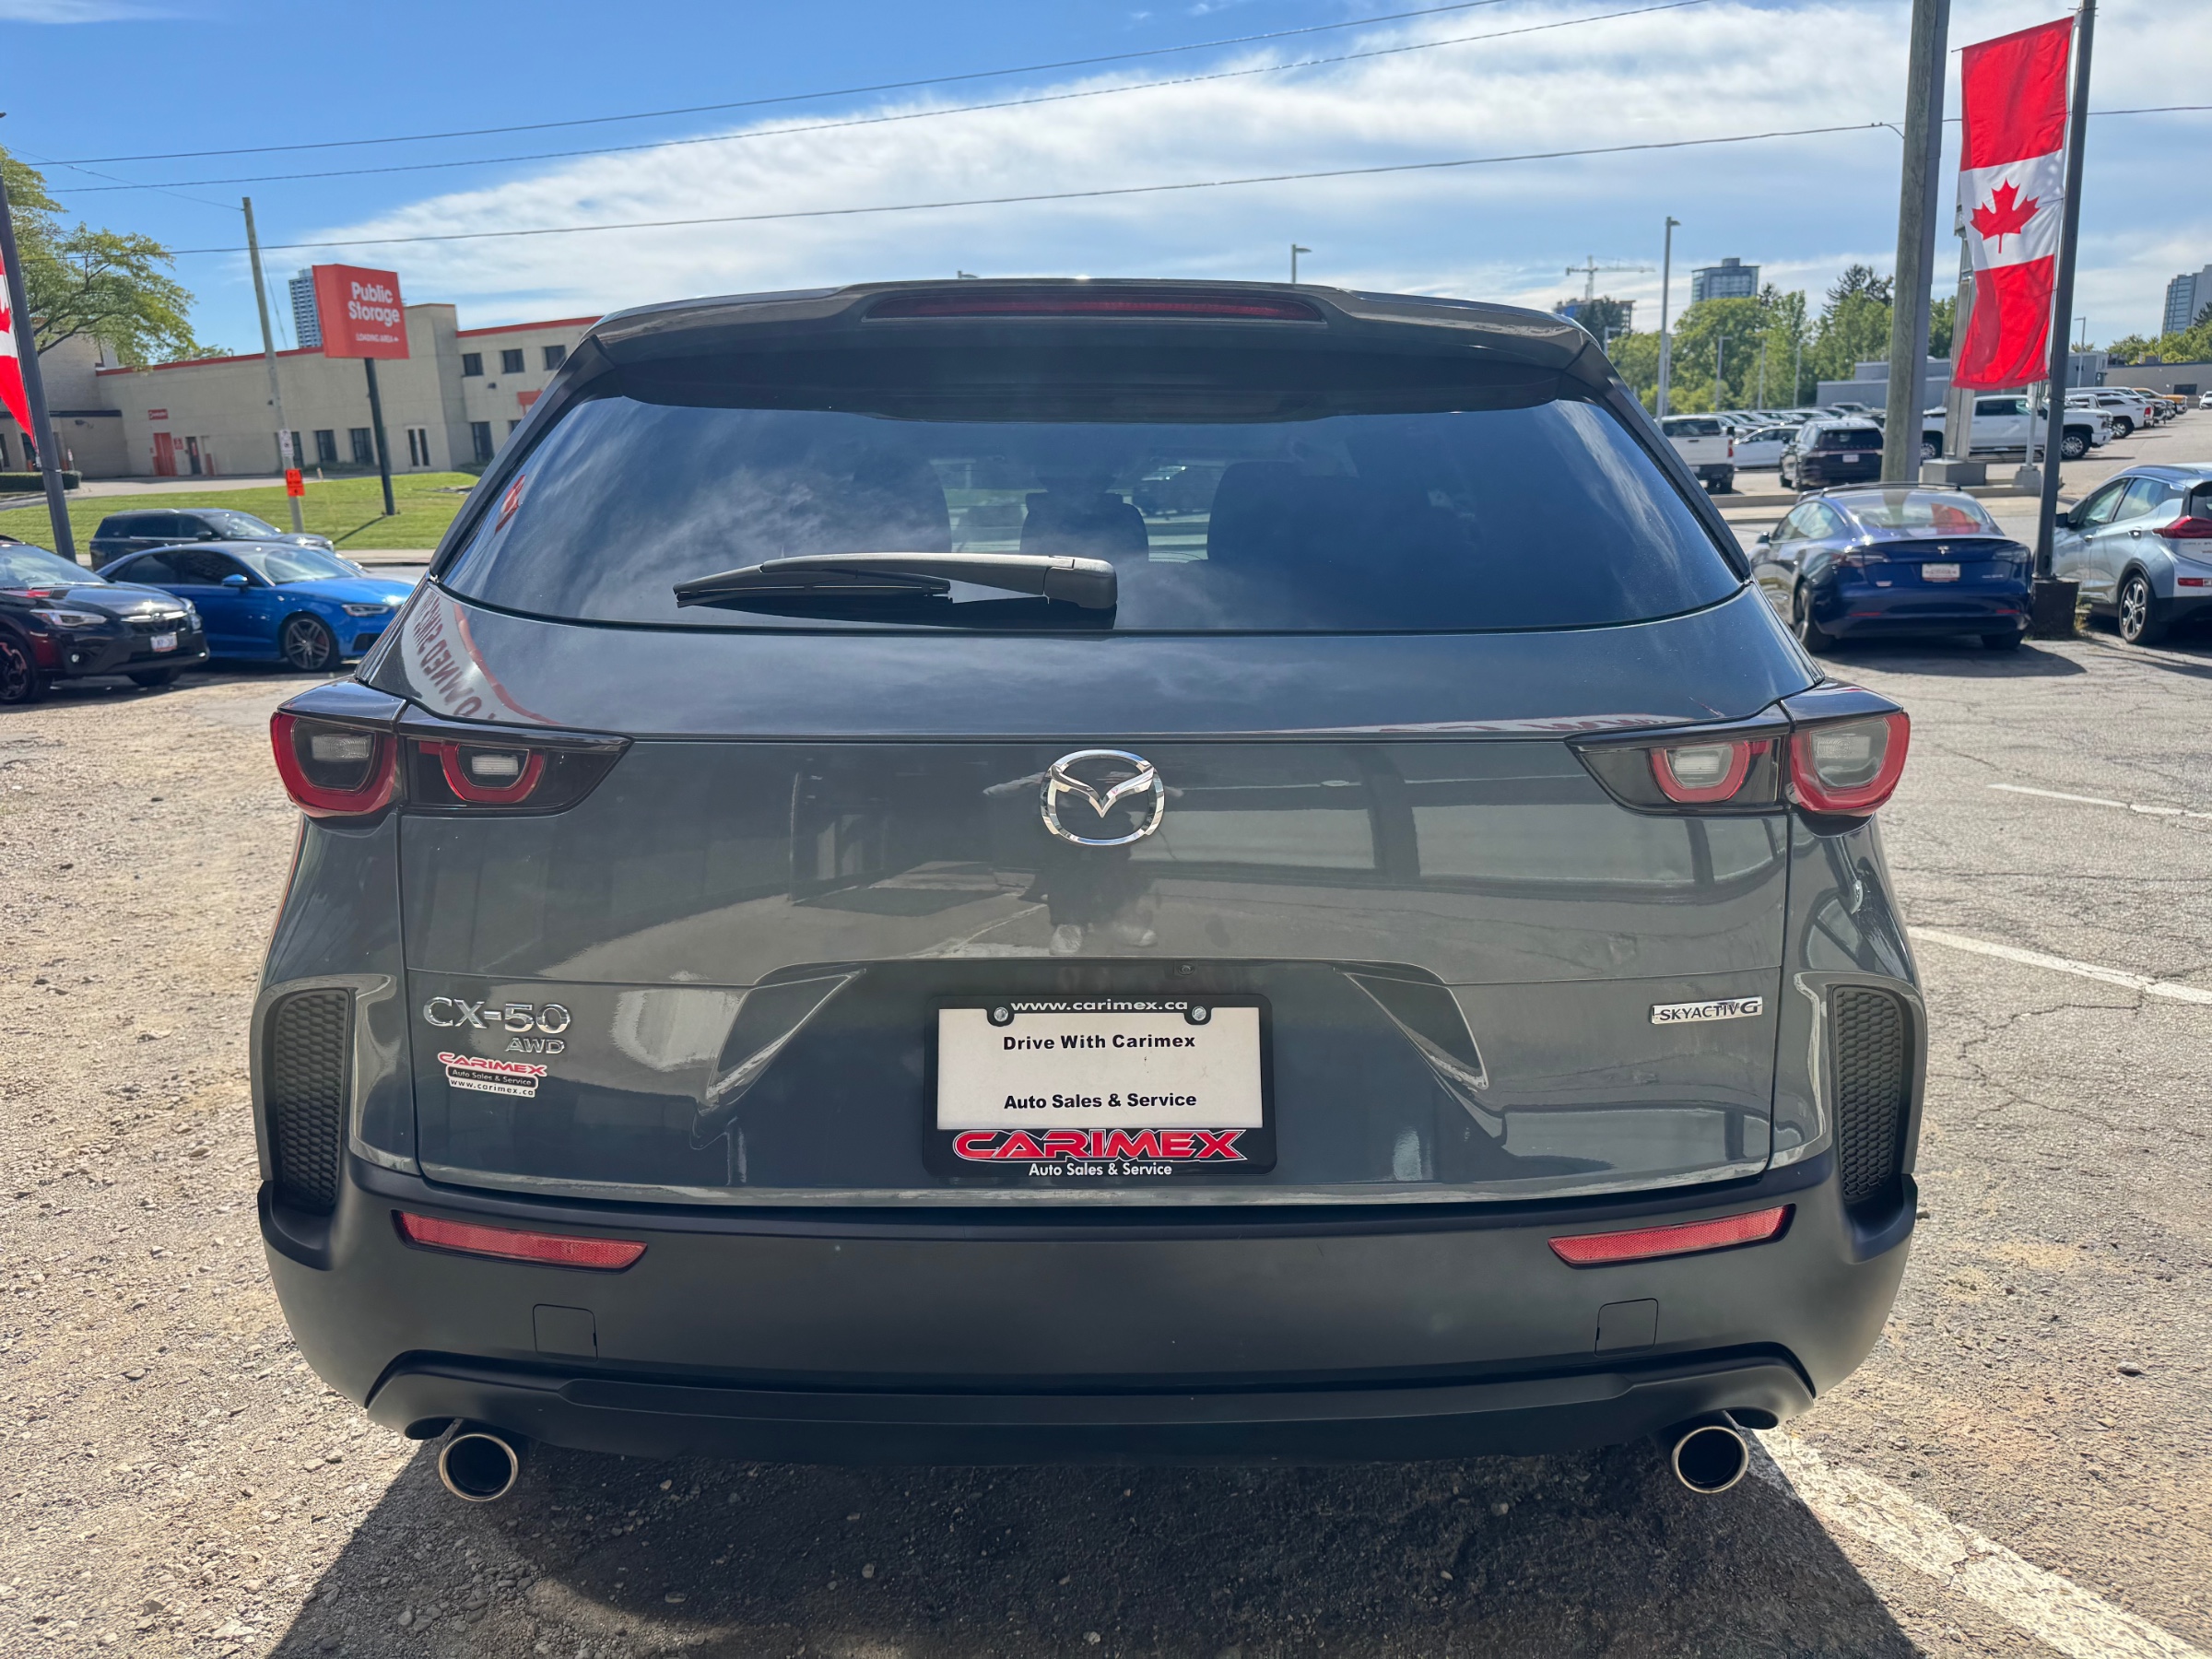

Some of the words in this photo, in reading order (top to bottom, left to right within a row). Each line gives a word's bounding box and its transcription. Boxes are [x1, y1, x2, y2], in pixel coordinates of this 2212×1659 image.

[351, 281, 393, 303] Public
[347, 300, 400, 327] Storage
[1011, 999, 1188, 1011] www.carimex.ca
[423, 996, 571, 1034] CX-50
[505, 1037, 565, 1054] AWD
[1003, 1035, 1055, 1051] Drive
[1061, 1034, 1106, 1049] With
[1112, 1034, 1196, 1049] Carimex
[439, 1053, 547, 1076] CARIMEX
[451, 1078, 534, 1096] www.carimex.ca
[452, 1069, 470, 1078] Auto
[472, 1072, 493, 1082] Sales
[503, 1077, 532, 1087] Service
[1004, 1095, 1047, 1110] Auto
[1052, 1094, 1102, 1108] Sales
[1108, 1094, 1122, 1107] &
[1127, 1092, 1197, 1107] Service
[952, 1130, 1247, 1162] CARIMEX
[1029, 1163, 1062, 1176] Auto
[1066, 1163, 1103, 1176] Sales
[1108, 1163, 1118, 1175] &
[1123, 1162, 1172, 1175] Service
